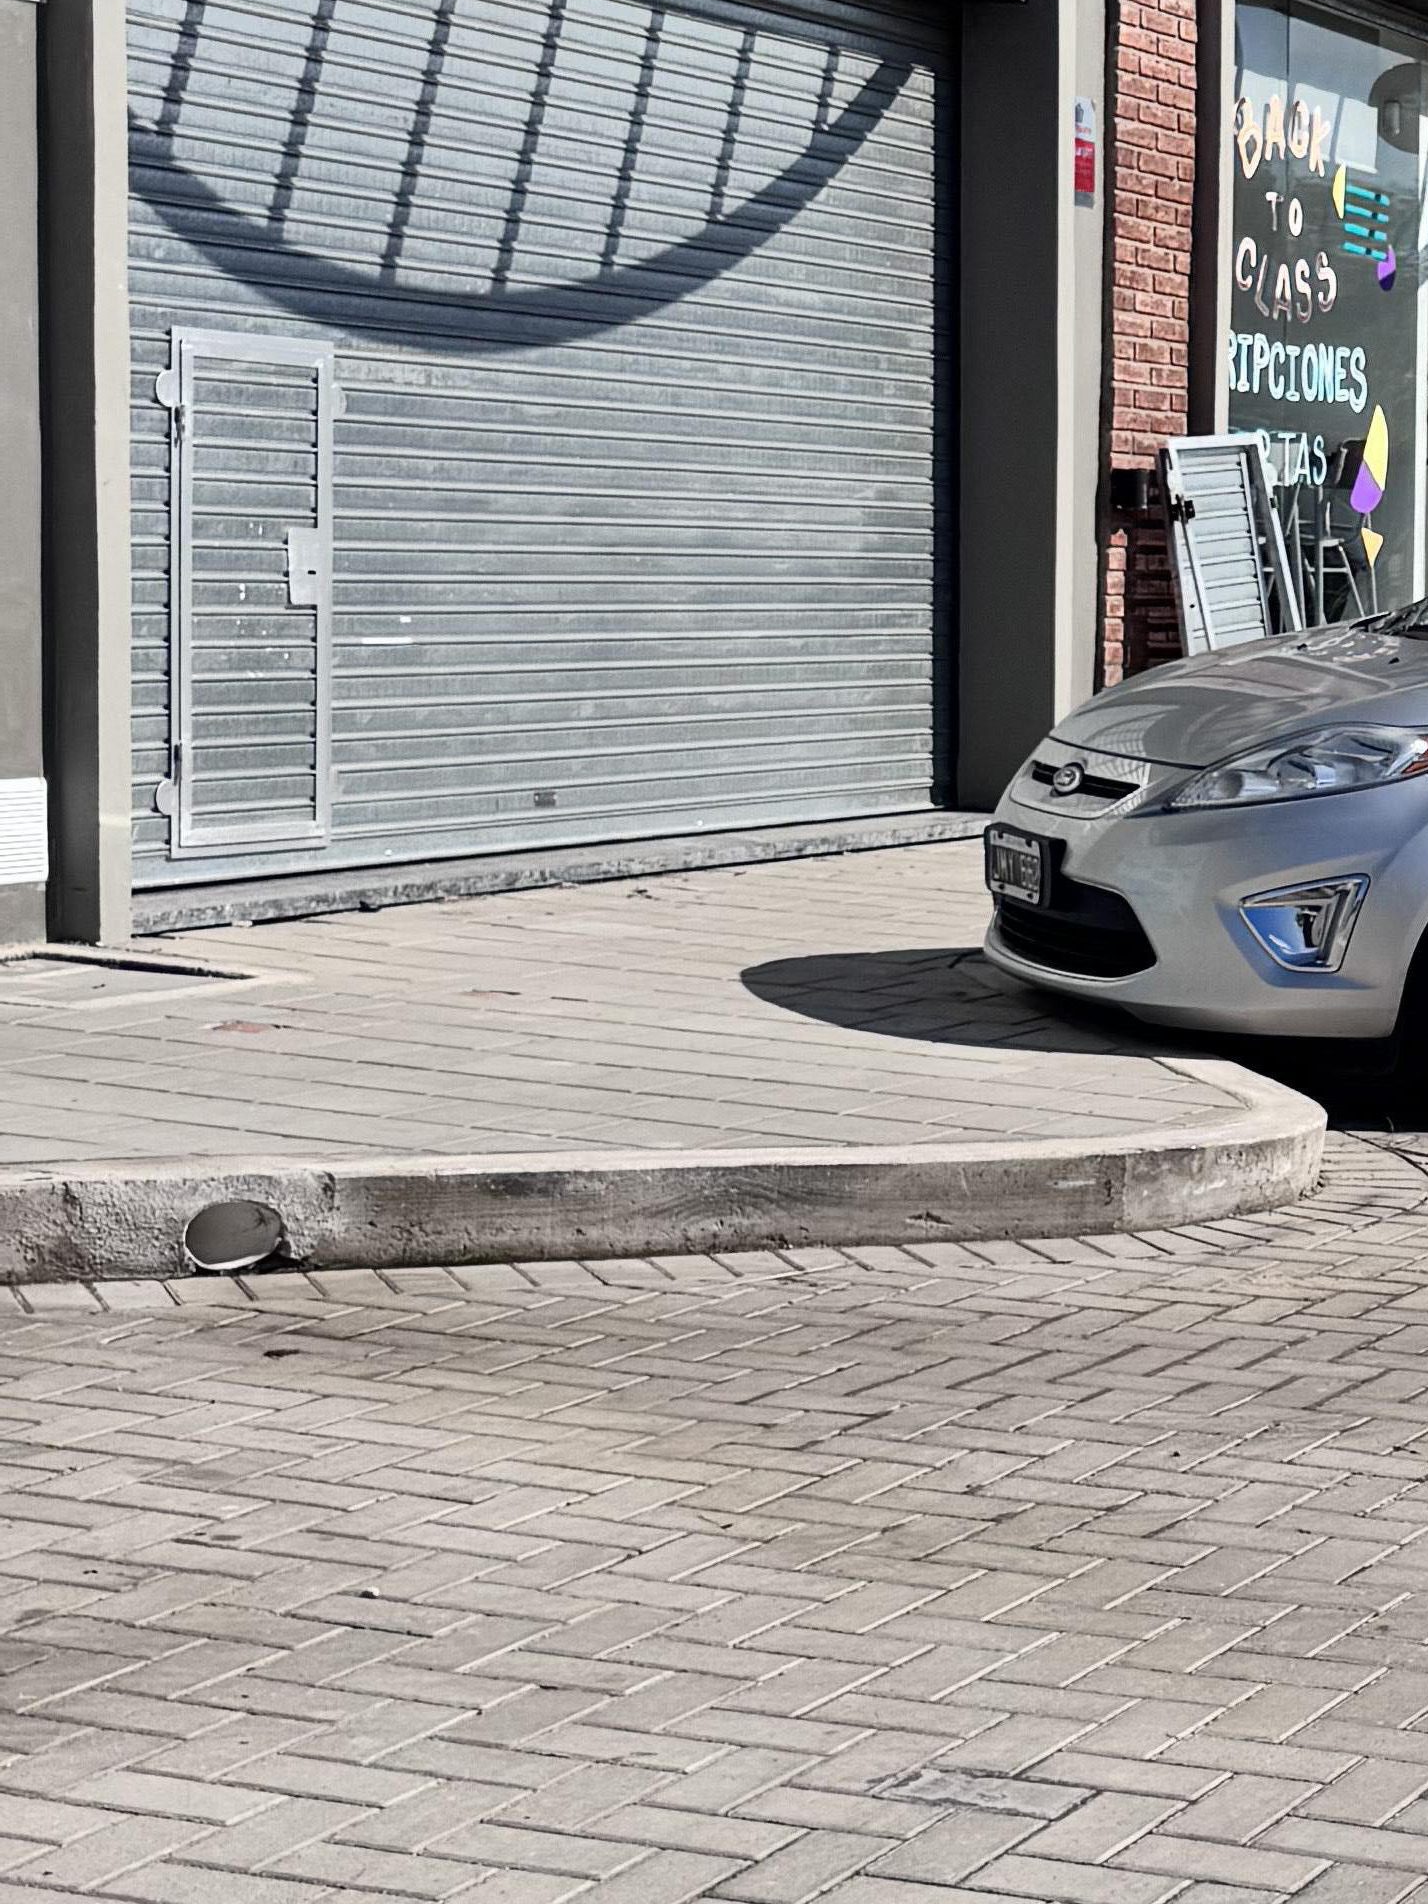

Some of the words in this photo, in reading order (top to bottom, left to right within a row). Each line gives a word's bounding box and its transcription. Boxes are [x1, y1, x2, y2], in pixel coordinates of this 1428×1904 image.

[1234, 94, 1331, 179] BACK
[1265, 191, 1304, 237] TO
[1235, 236, 1337, 324] CLASS
